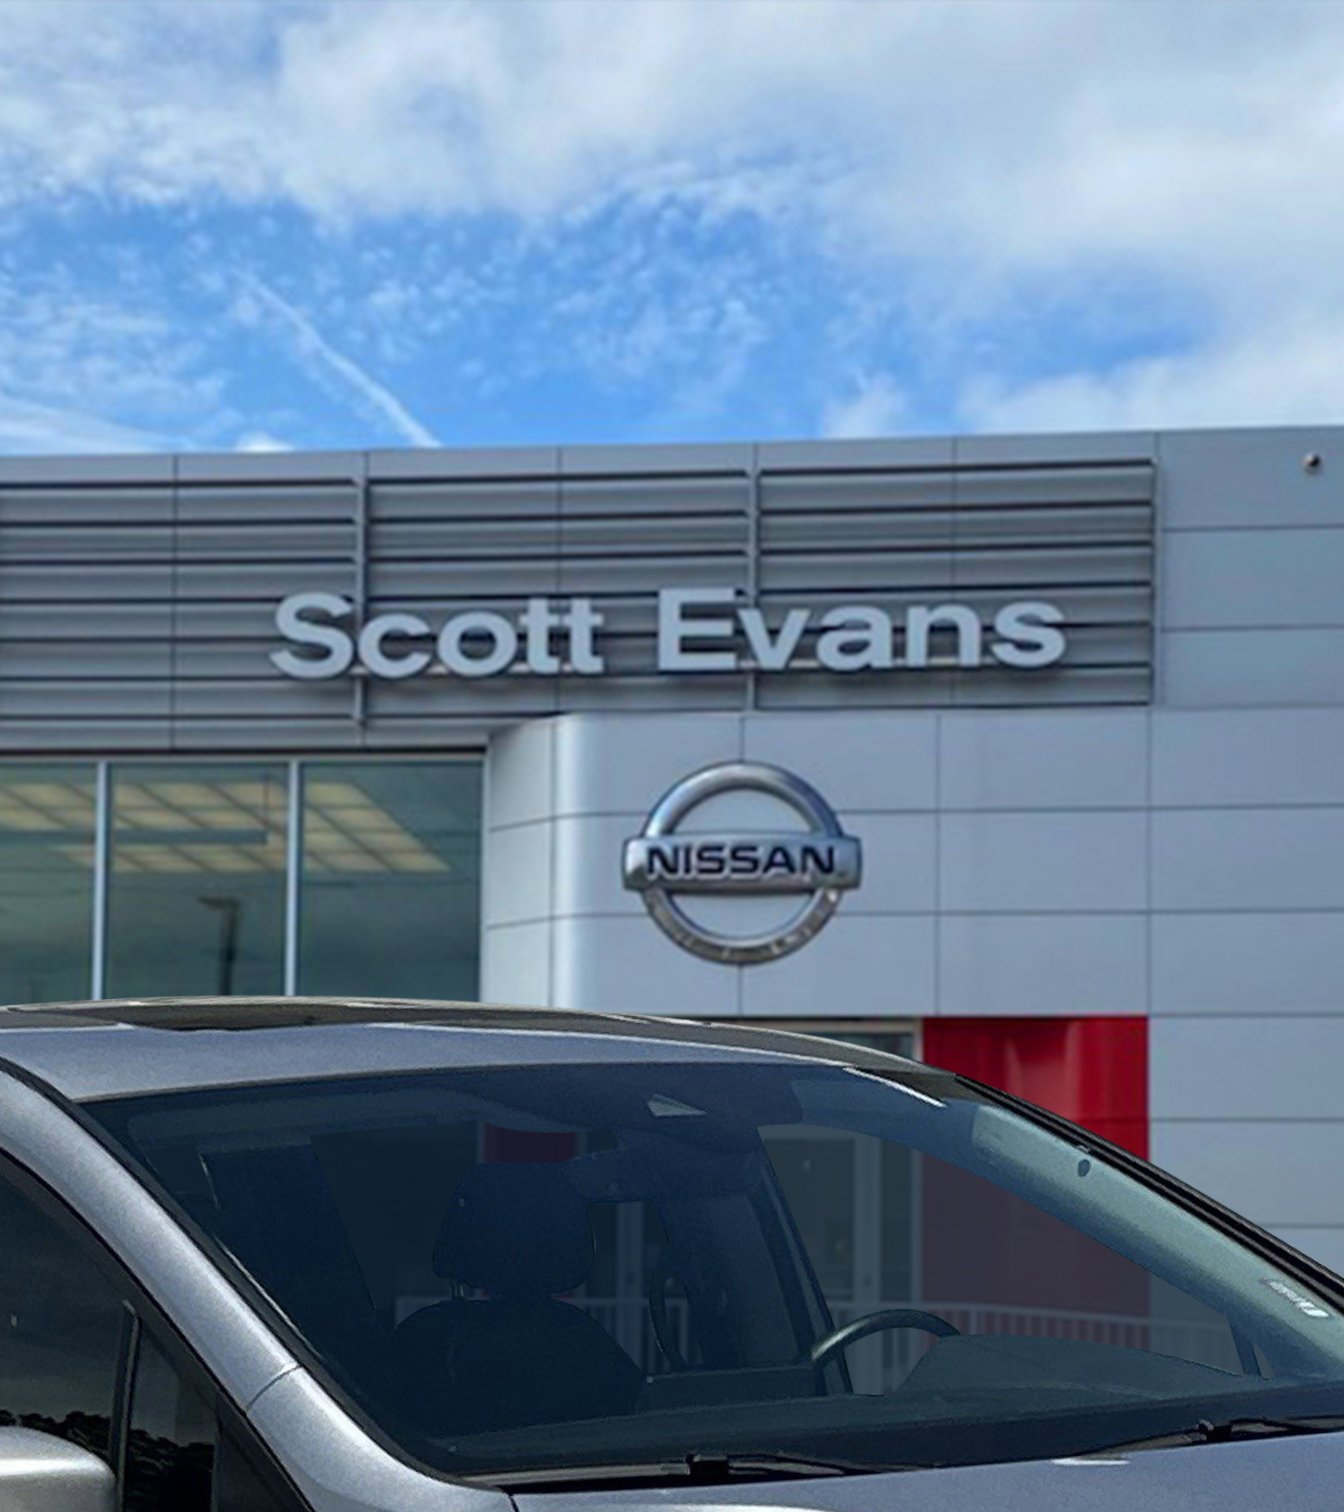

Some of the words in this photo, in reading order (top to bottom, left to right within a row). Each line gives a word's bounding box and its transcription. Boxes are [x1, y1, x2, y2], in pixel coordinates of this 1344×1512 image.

[269, 592, 605, 679] Scott
[659, 586, 1067, 673] Evans
[645, 845, 836, 876] NISSAN
